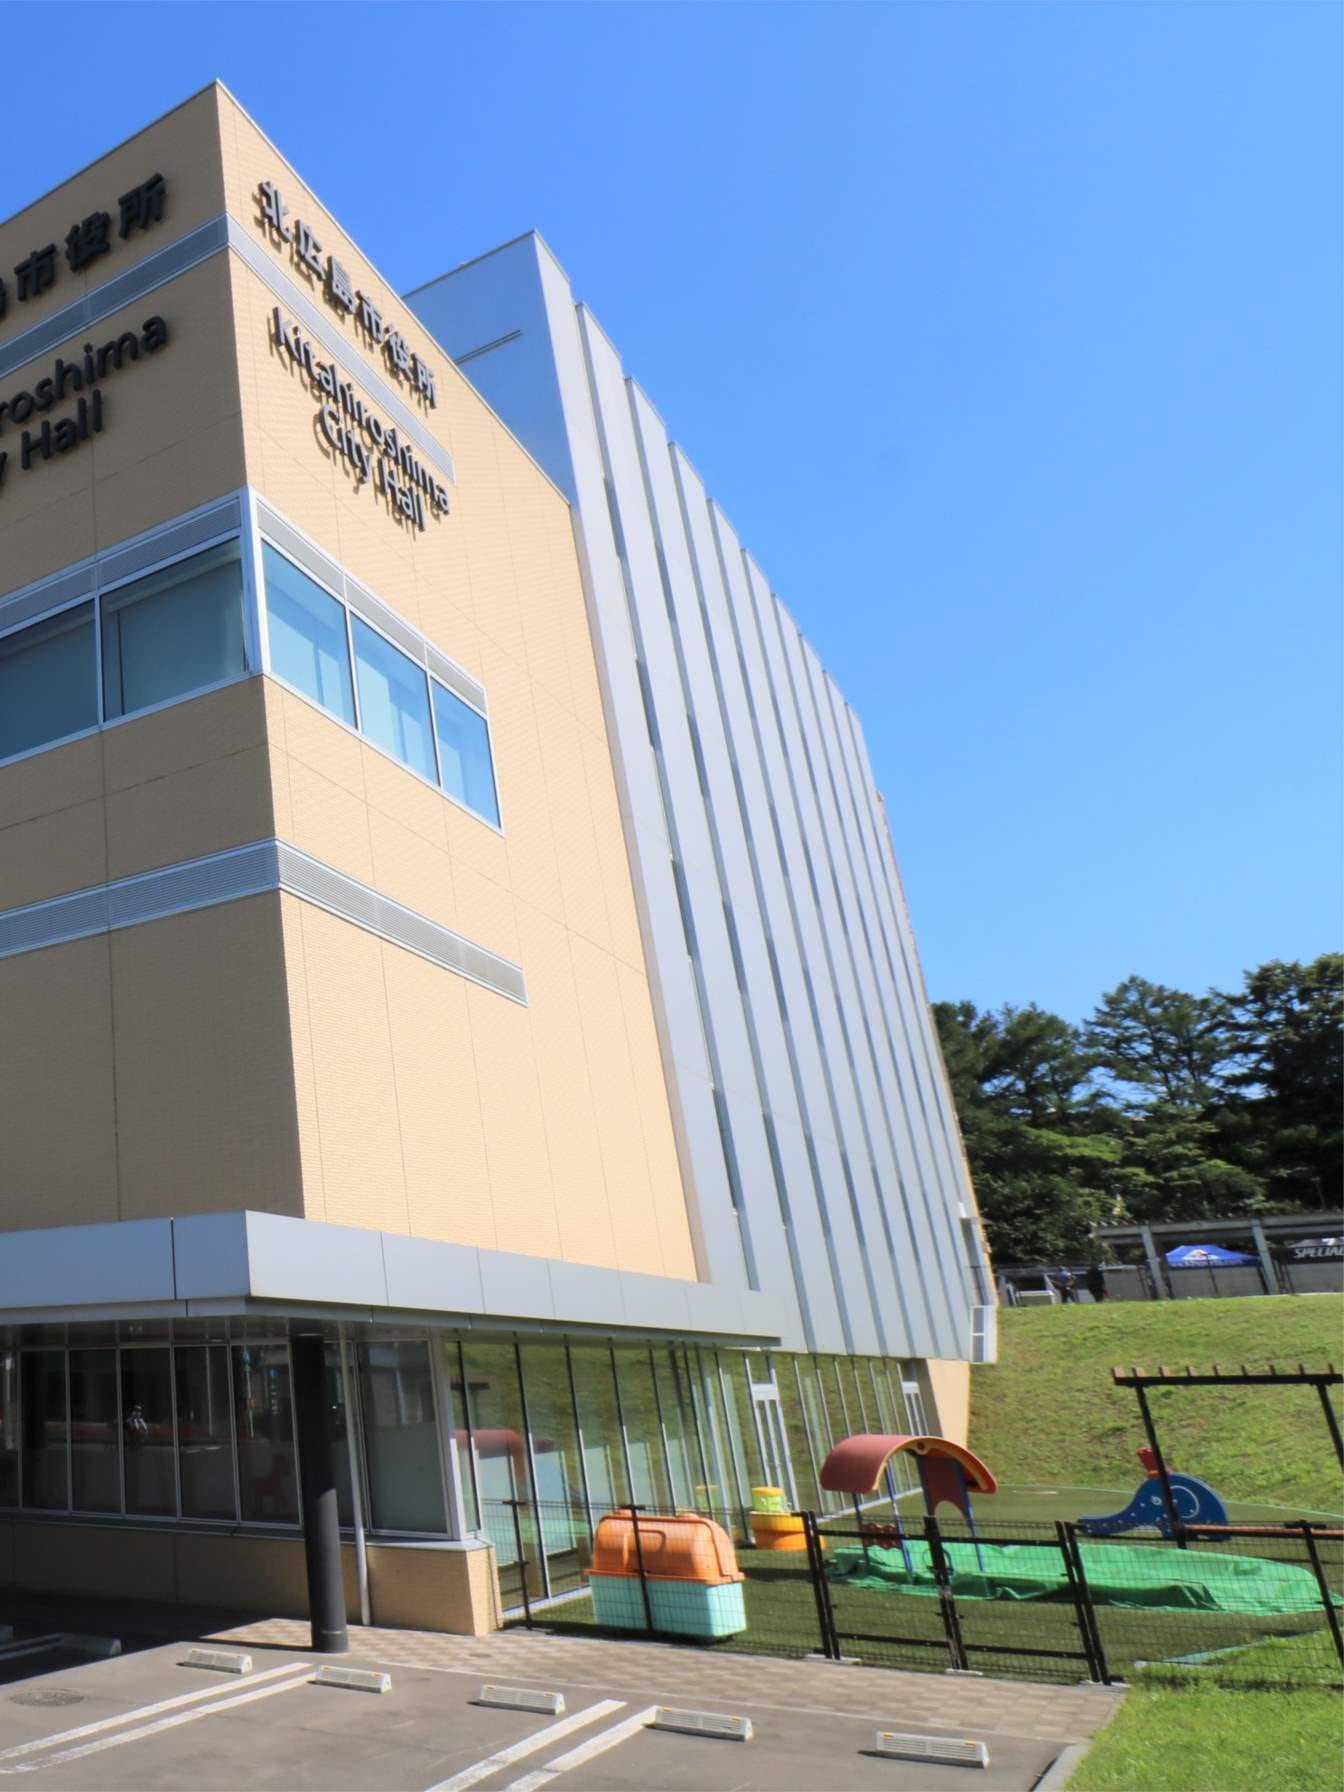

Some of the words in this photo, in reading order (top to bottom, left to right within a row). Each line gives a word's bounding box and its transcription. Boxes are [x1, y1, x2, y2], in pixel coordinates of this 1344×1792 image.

[258, 181, 436, 409] 北広島市役所
[21, 389, 103, 470] Hall
[272, 307, 449, 515] Kitahiroshima
[320, 403, 373, 485] City
[376, 457, 425, 532] Hall
